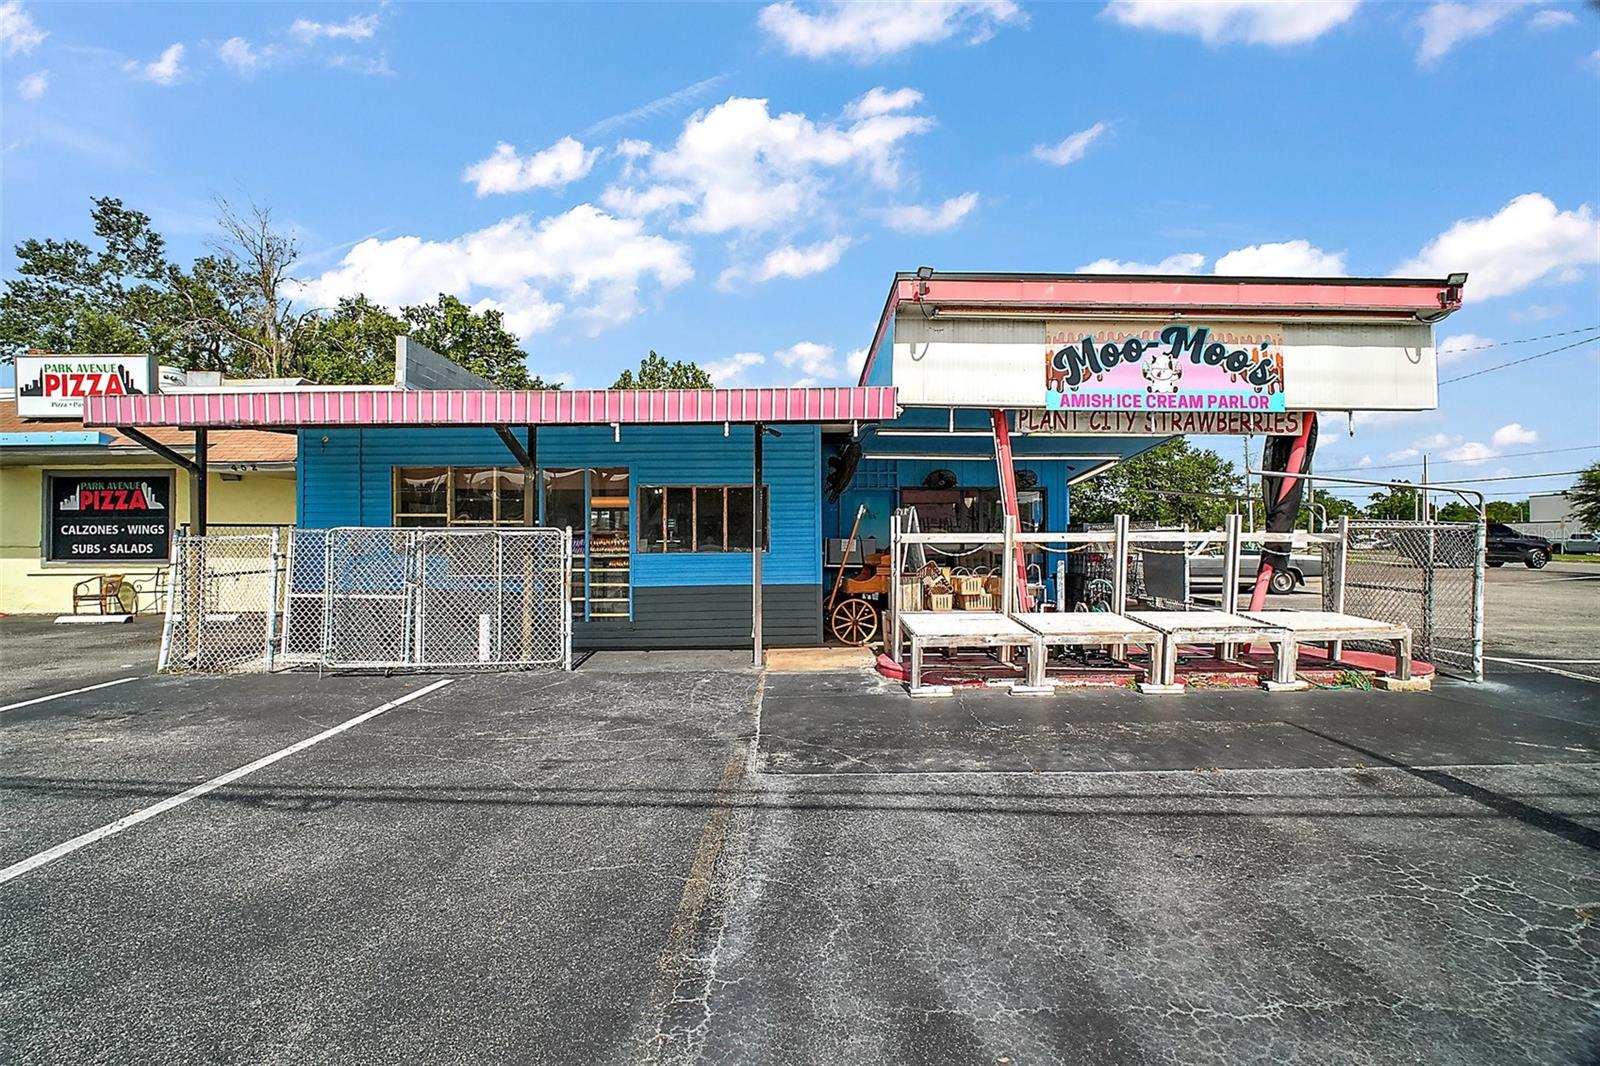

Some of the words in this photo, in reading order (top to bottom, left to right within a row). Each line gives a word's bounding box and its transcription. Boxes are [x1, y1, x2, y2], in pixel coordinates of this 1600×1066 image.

[1053, 325, 1281, 387] Moo-Moo's
[44, 363, 73, 373] PARK
[77, 363, 117, 373] AVENUE
[44, 374, 124, 397] PIZZA
[1060, 394, 1113, 409] AMISH
[1117, 395, 1141, 409] ICE
[1145, 394, 1205, 409] CREAM
[1208, 395, 1270, 410] PARLOR
[1018, 409, 1079, 432] PLANT
[1089, 410, 1137, 432] CITY
[1144, 411, 1299, 434] STRAWBERRIES
[80, 481, 105, 490] PARK
[107, 481, 141, 490] AVENUE
[80, 490, 147, 511] PIZZA
[60, 524, 119, 535] CALZONES
[127, 524, 165, 535] WINGS
[71, 543, 101, 554] SUBS
[109, 543, 153, 554] SALADS
